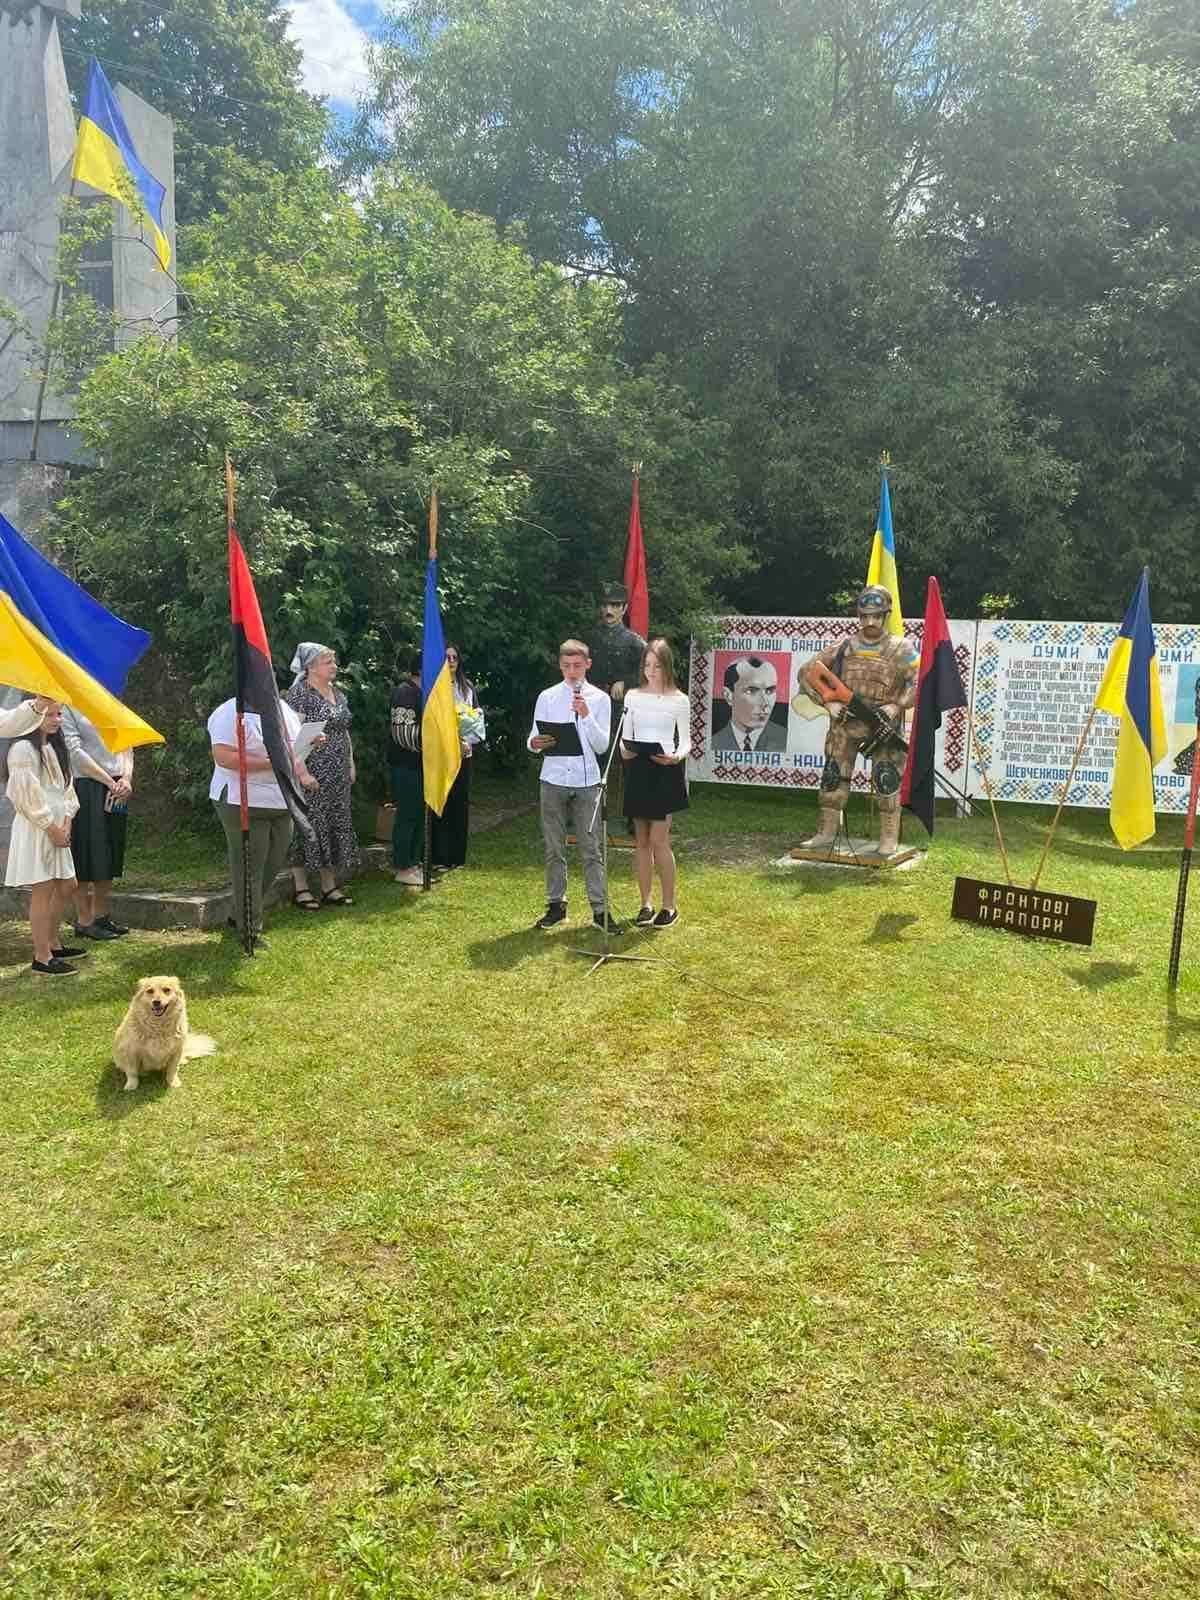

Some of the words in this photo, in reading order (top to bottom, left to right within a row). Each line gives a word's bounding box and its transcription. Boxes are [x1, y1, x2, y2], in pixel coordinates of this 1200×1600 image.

[713, 638, 752, 650] АТЬКО
[757, 639, 782, 651] НАШ
[1033, 645, 1079, 659] ДУМИ
[1160, 650, 1193, 663] УМИ
[1074, 770, 1109, 783] СЛОВО
[978, 887, 1069, 916] ФРОНТОВІ
[979, 904, 1063, 933] ПРАПОРИ
